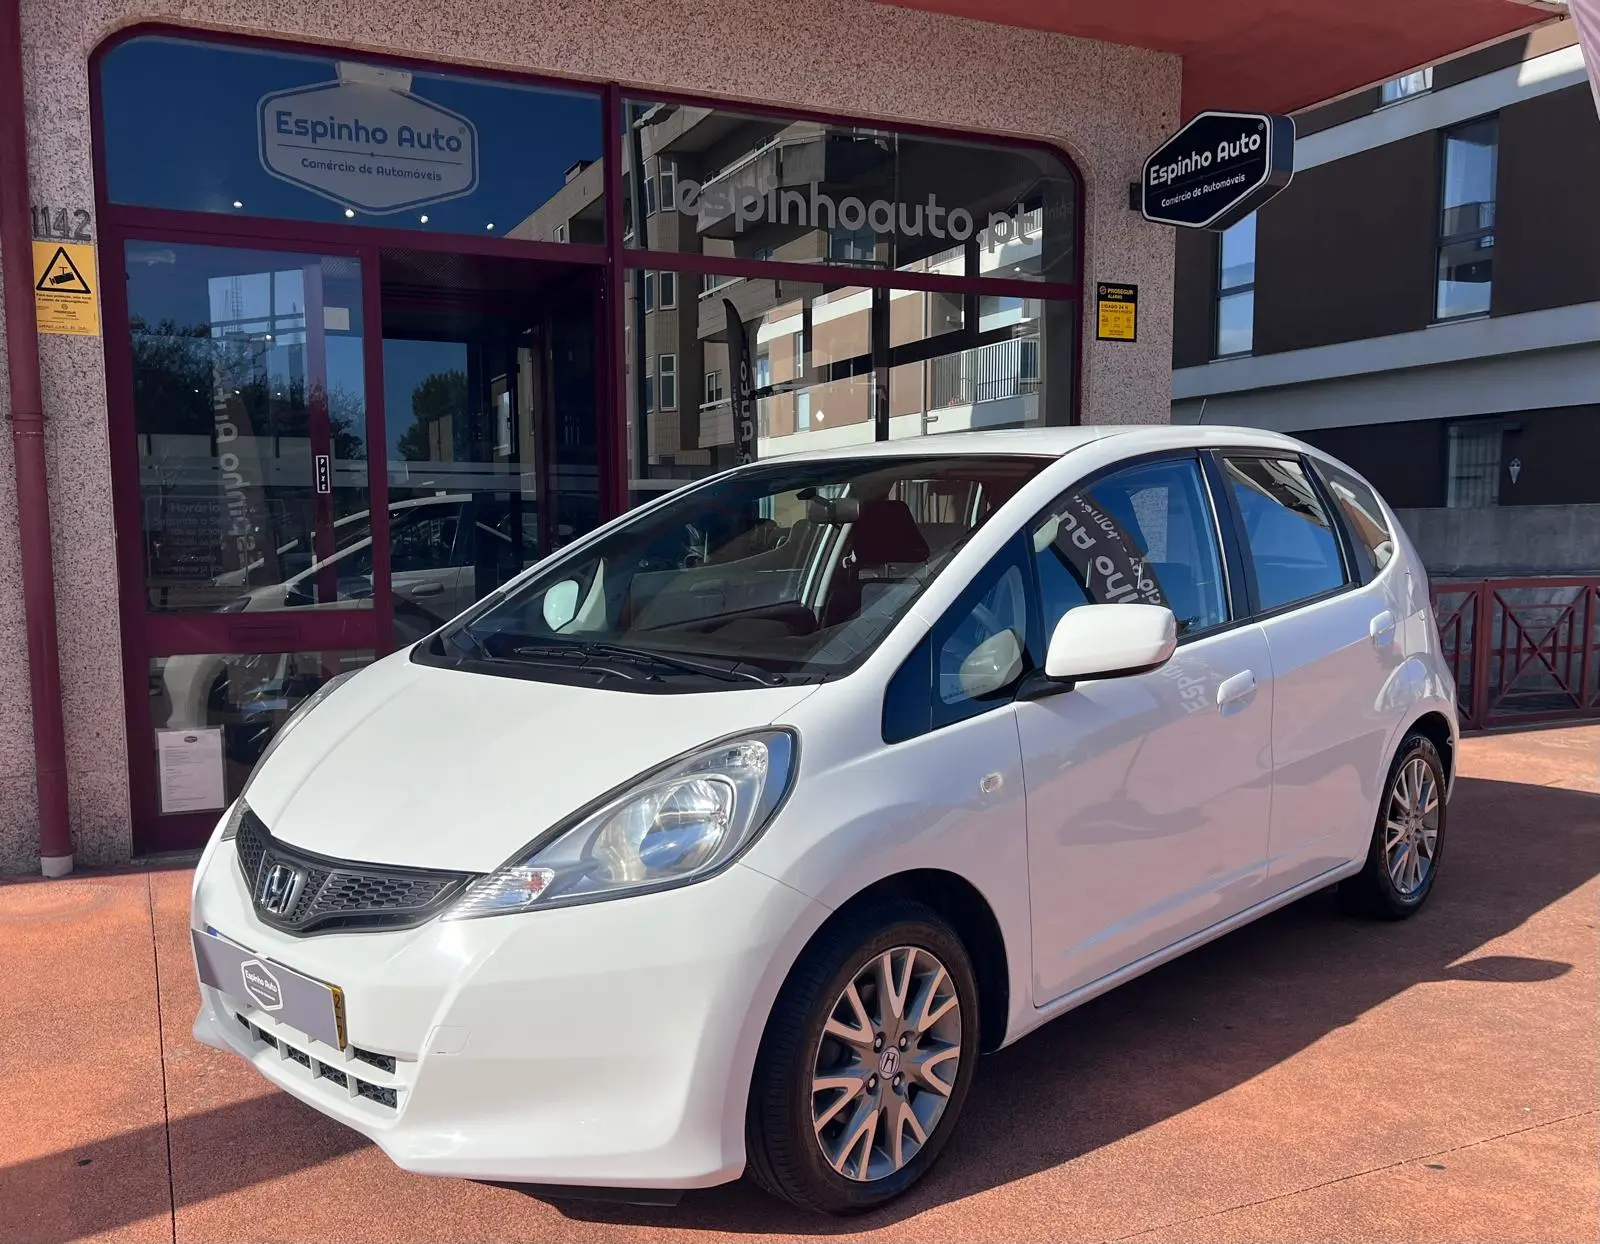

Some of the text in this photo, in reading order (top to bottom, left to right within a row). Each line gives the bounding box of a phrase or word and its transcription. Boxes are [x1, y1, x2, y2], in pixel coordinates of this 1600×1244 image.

[276, 110, 463, 152] Espinho Auto
[301, 157, 442, 182] Comércio de Automóveis
[1150, 133, 1261, 186] Espinho Auto
[1161, 173, 1246, 208] Comércio de Automóveis
[31, 205, 91, 241] 1142
[674, 175, 1035, 253] espinhoauto.pt
